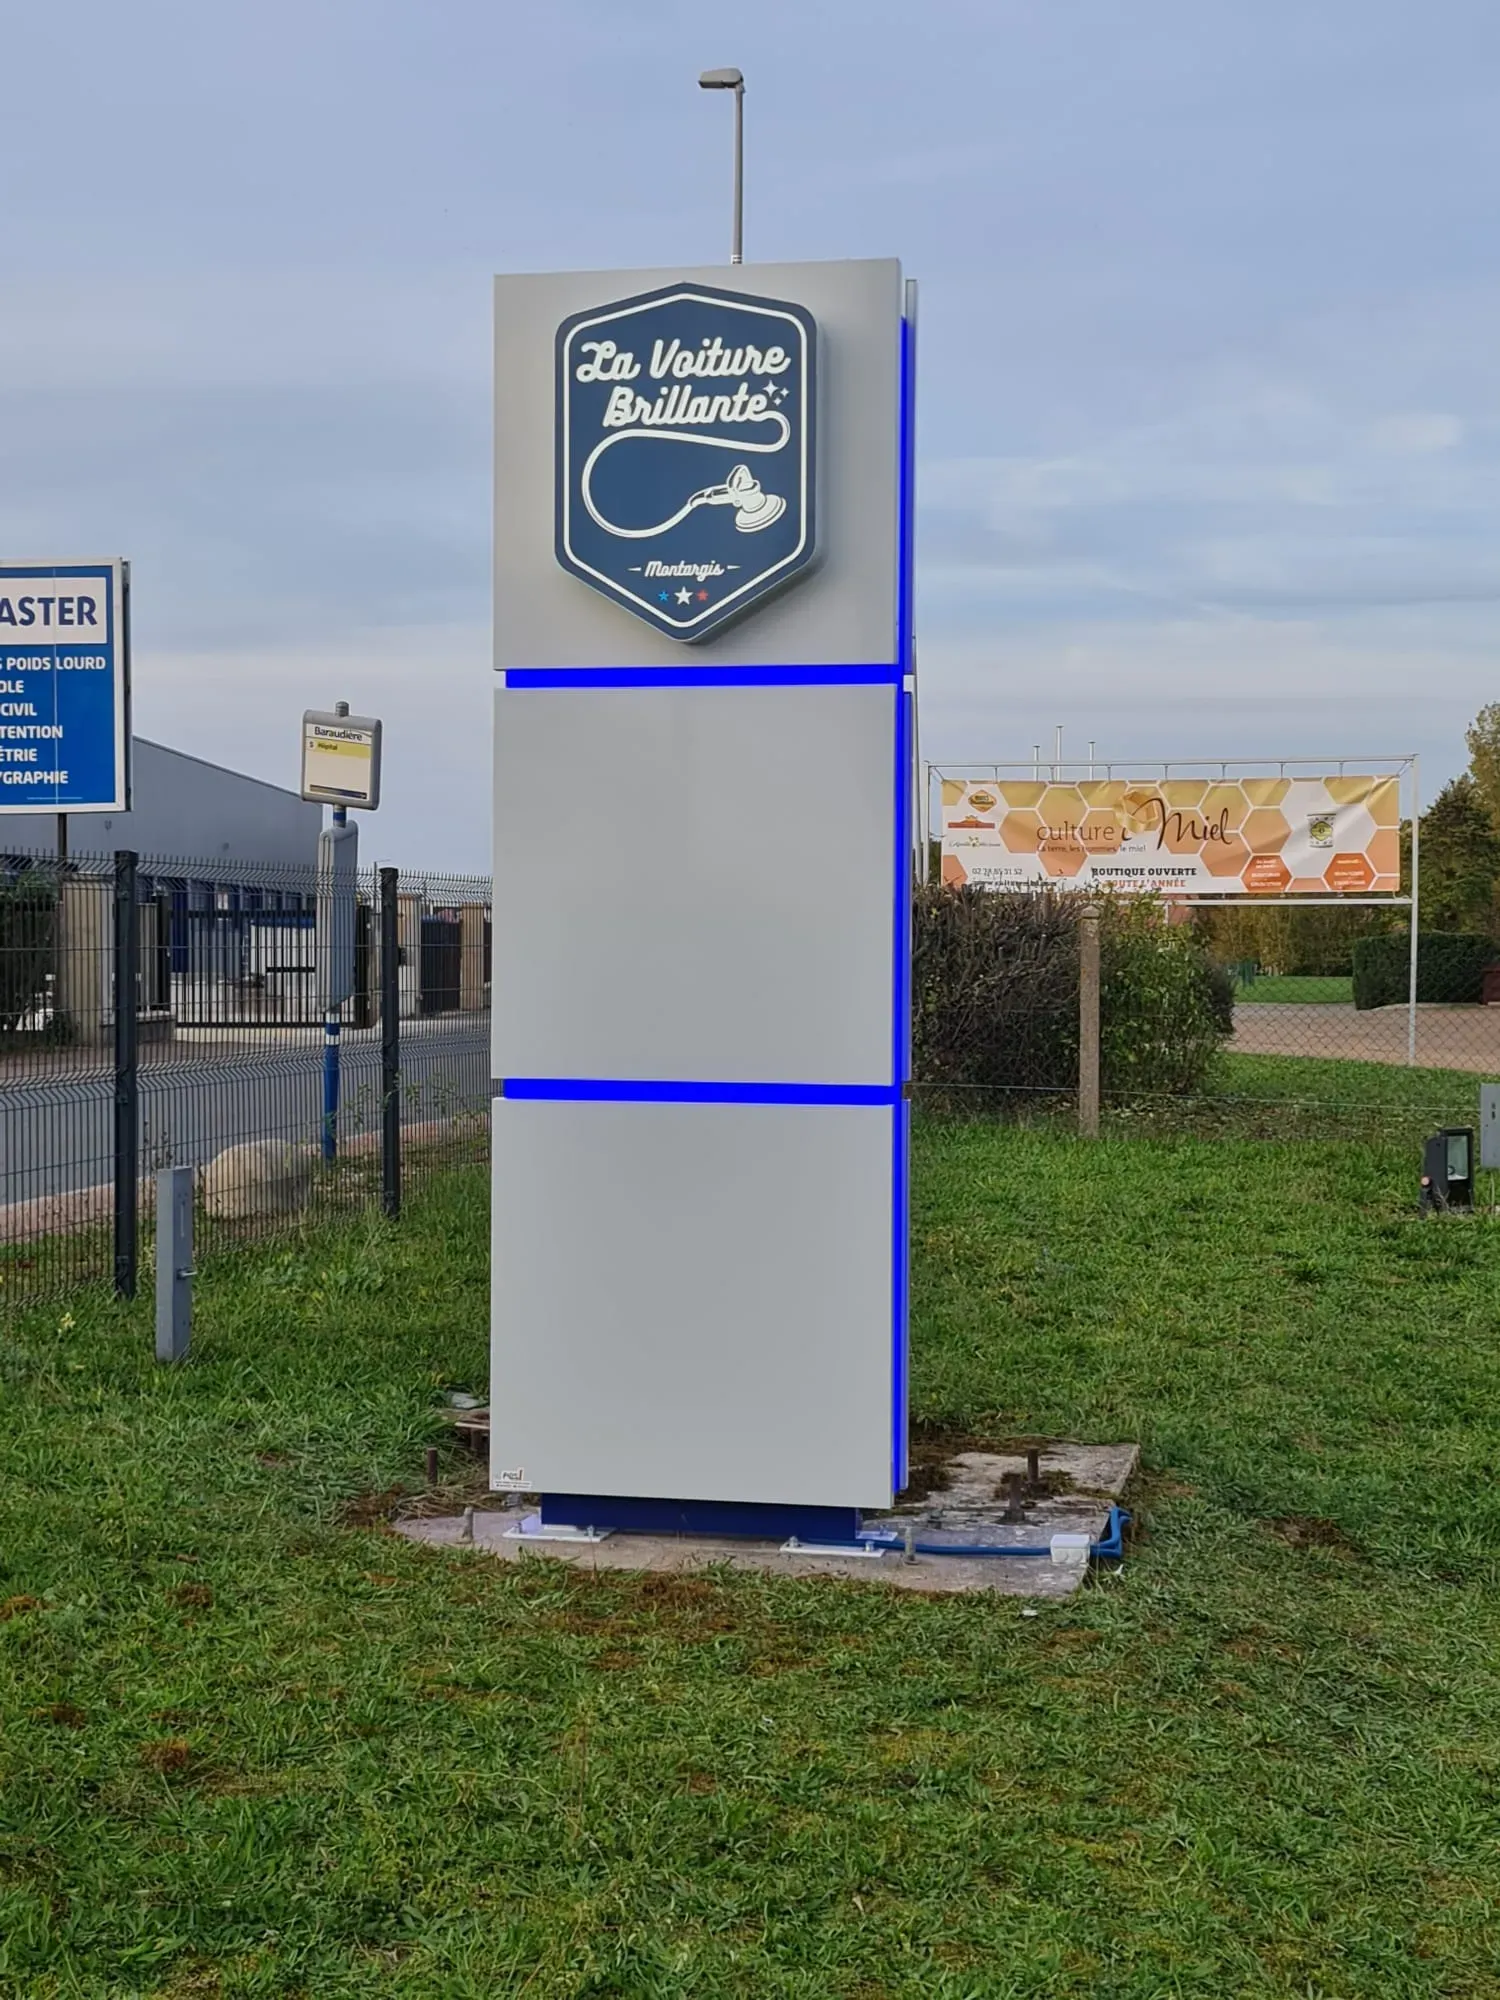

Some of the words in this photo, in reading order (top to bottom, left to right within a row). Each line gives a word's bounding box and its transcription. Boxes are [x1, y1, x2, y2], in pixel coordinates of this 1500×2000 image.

[575, 339, 641, 383] La
[649, 336, 792, 380] Voiture
[602, 381, 770, 428] Brillante
[644, 560, 726, 582] Montargis
[6, 656, 51, 671] POIDS
[55, 655, 106, 671] LOURD
[0, 702, 38, 717] CIVIL
[0, 770, 69, 785] GRAPHIE
[1036, 820, 1116, 842] culture
[1131, 797, 1233, 851] Miel
[1091, 867, 1146, 877] BOUTIQUE
[1147, 867, 1198, 876] OUVERTE
